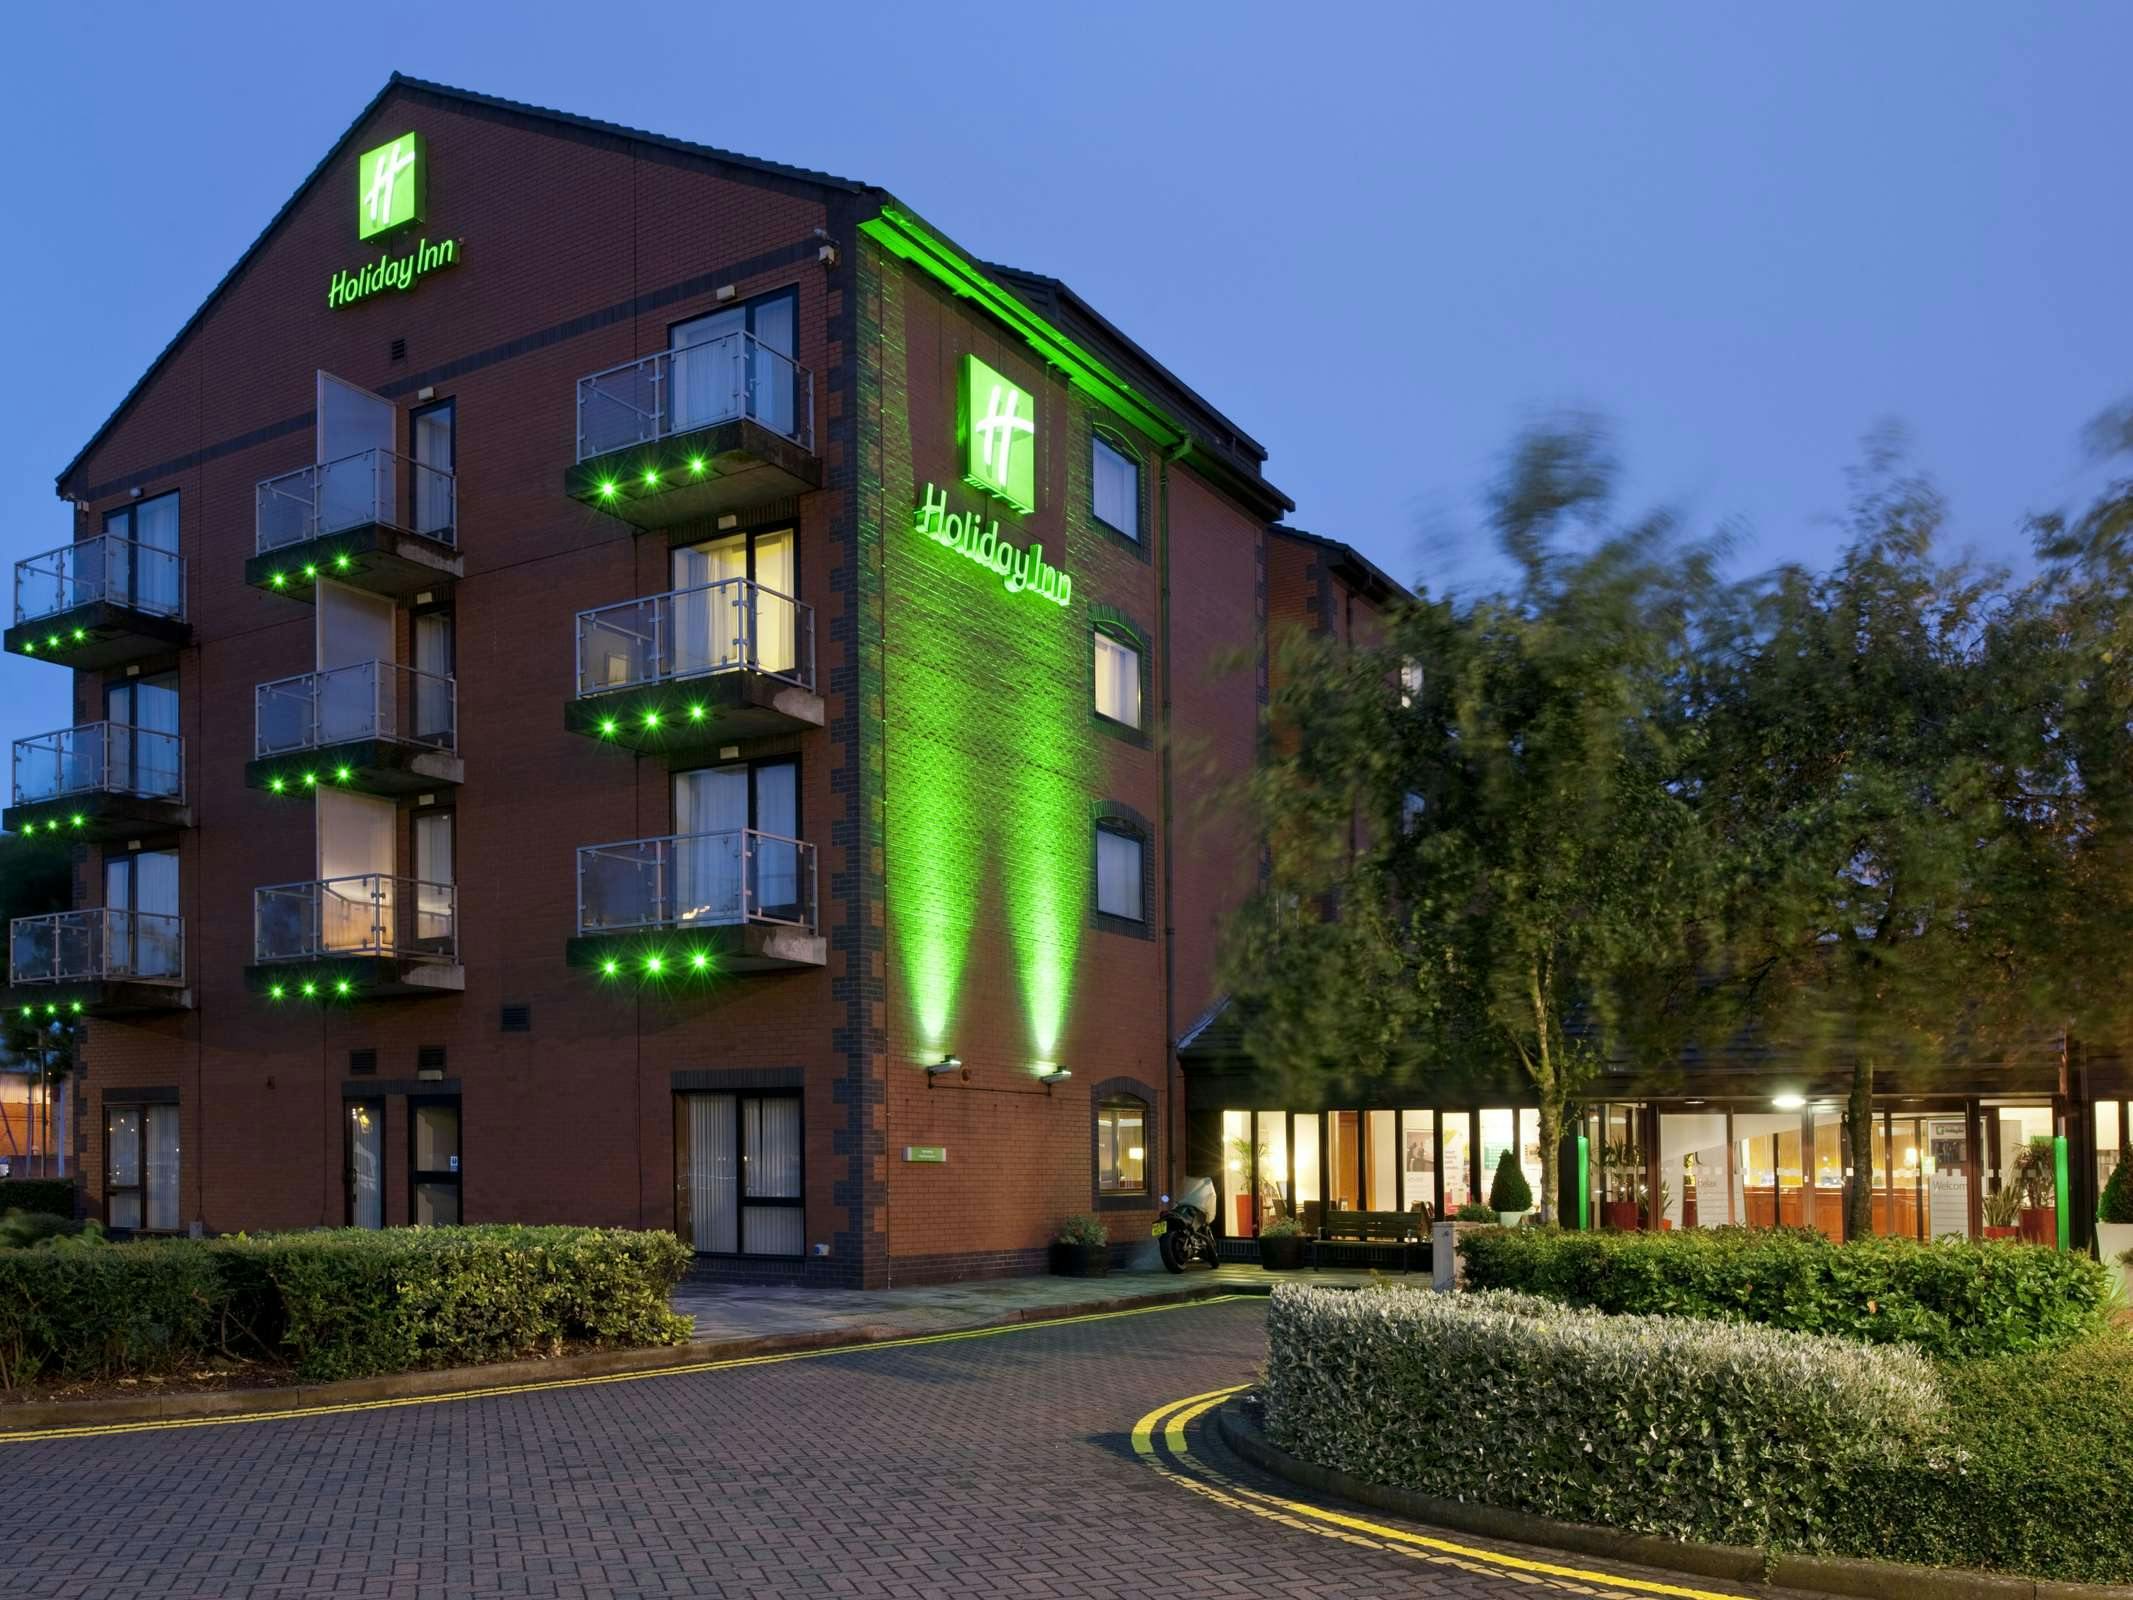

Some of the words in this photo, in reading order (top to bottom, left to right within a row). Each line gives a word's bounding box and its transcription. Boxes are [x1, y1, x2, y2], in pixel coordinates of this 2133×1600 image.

[328, 255, 415, 308] Holiday
[416, 238, 454, 274] Inn
[914, 482, 1030, 592] Holiday
[1028, 544, 1072, 606] Inn
[1932, 1179, 1967, 1191] Welcom
